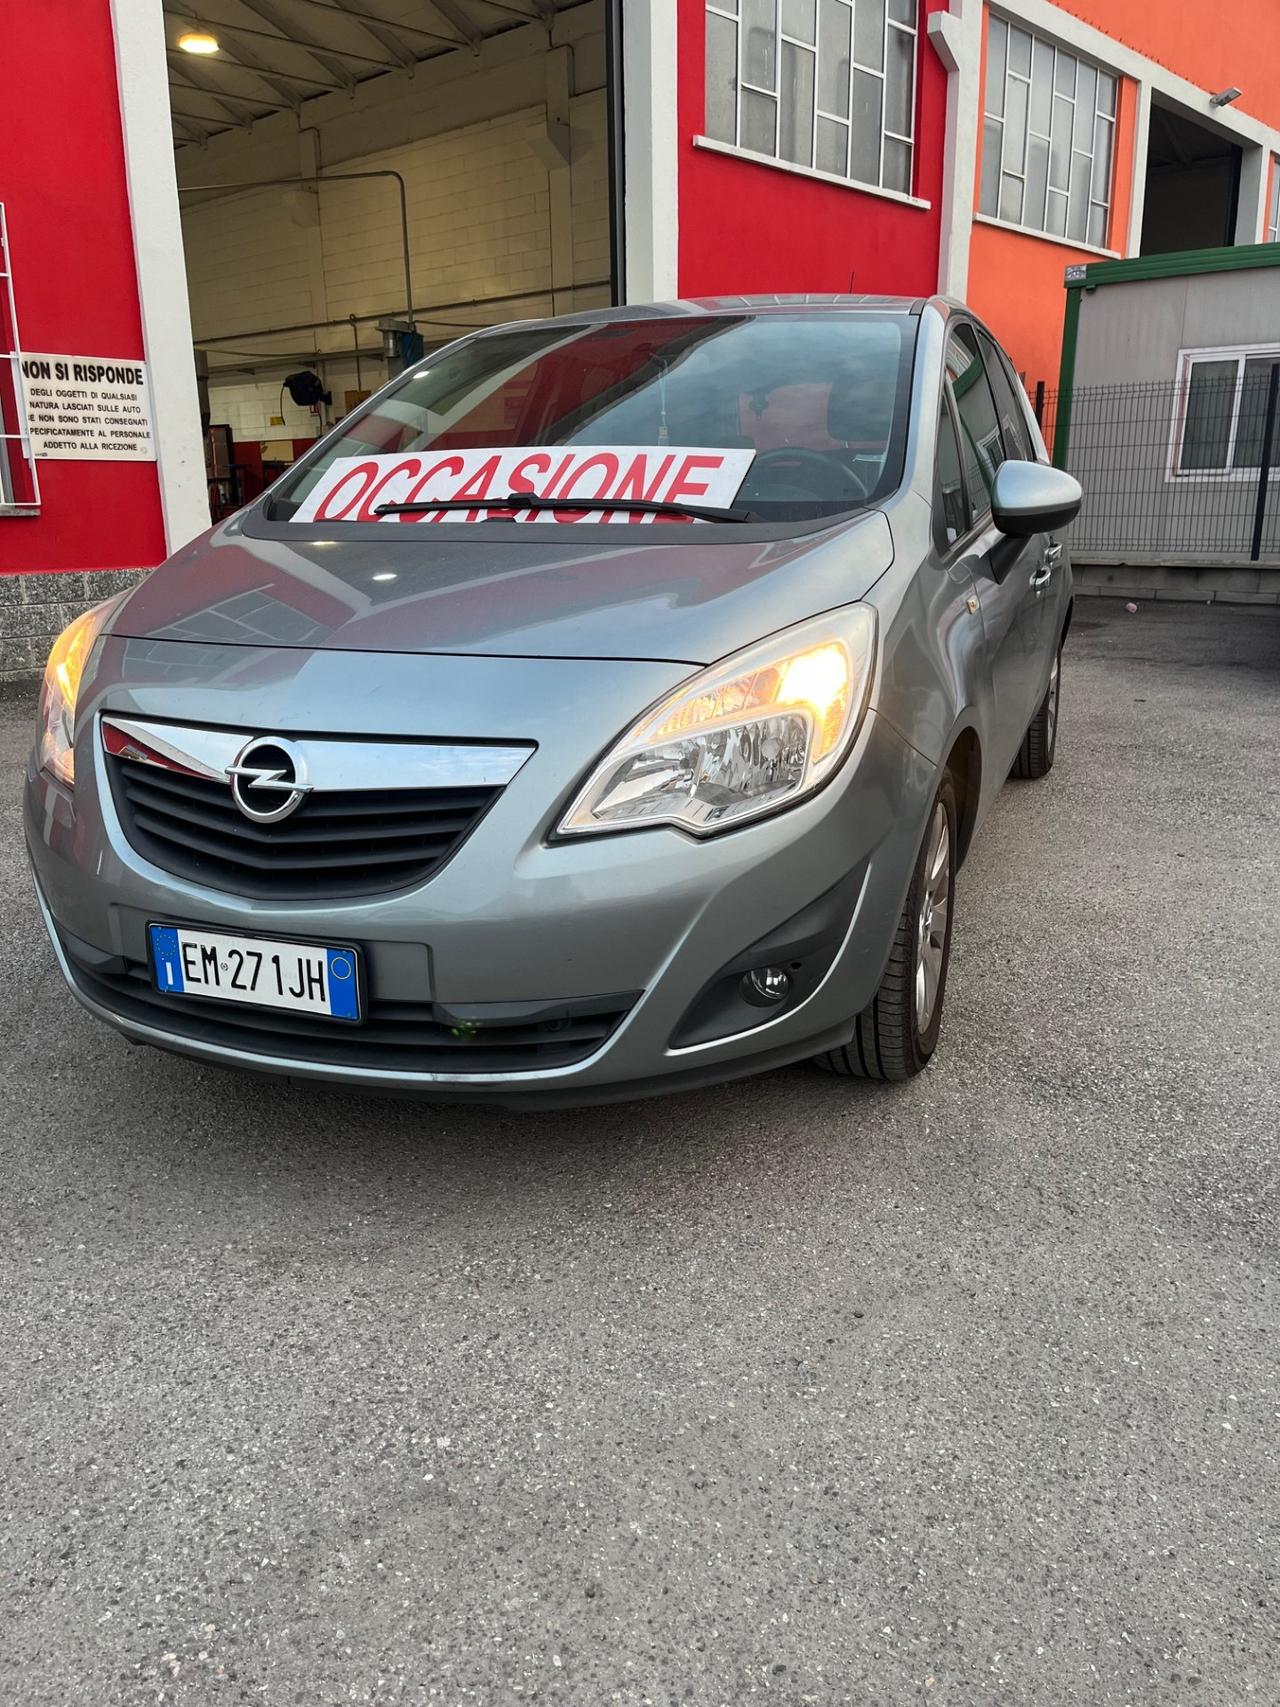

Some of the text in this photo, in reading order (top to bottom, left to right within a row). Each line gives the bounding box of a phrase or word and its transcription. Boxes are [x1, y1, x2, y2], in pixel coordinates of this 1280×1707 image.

[22, 360, 144, 385] NON SI RISPONDE
[30, 388, 52, 397] DEGLI
[56, 390, 87, 399] OGGETTI
[101, 392, 137, 401] QUALSIASI
[29, 401, 59, 410] NATURA
[62, 403, 94, 411] LASCIATI
[97, 405, 119, 413] SULLE
[82, 416, 101, 424] STATI
[104, 417, 148, 426] CONSEGNATI
[28, 427, 95, 437] PECIFICATAMENTE
[110, 430, 150, 439] PERSONALE
[43, 441, 137, 451] ADDETTO ALLA RICEZIONE
[313, 452, 725, 523] OCCASIONE
